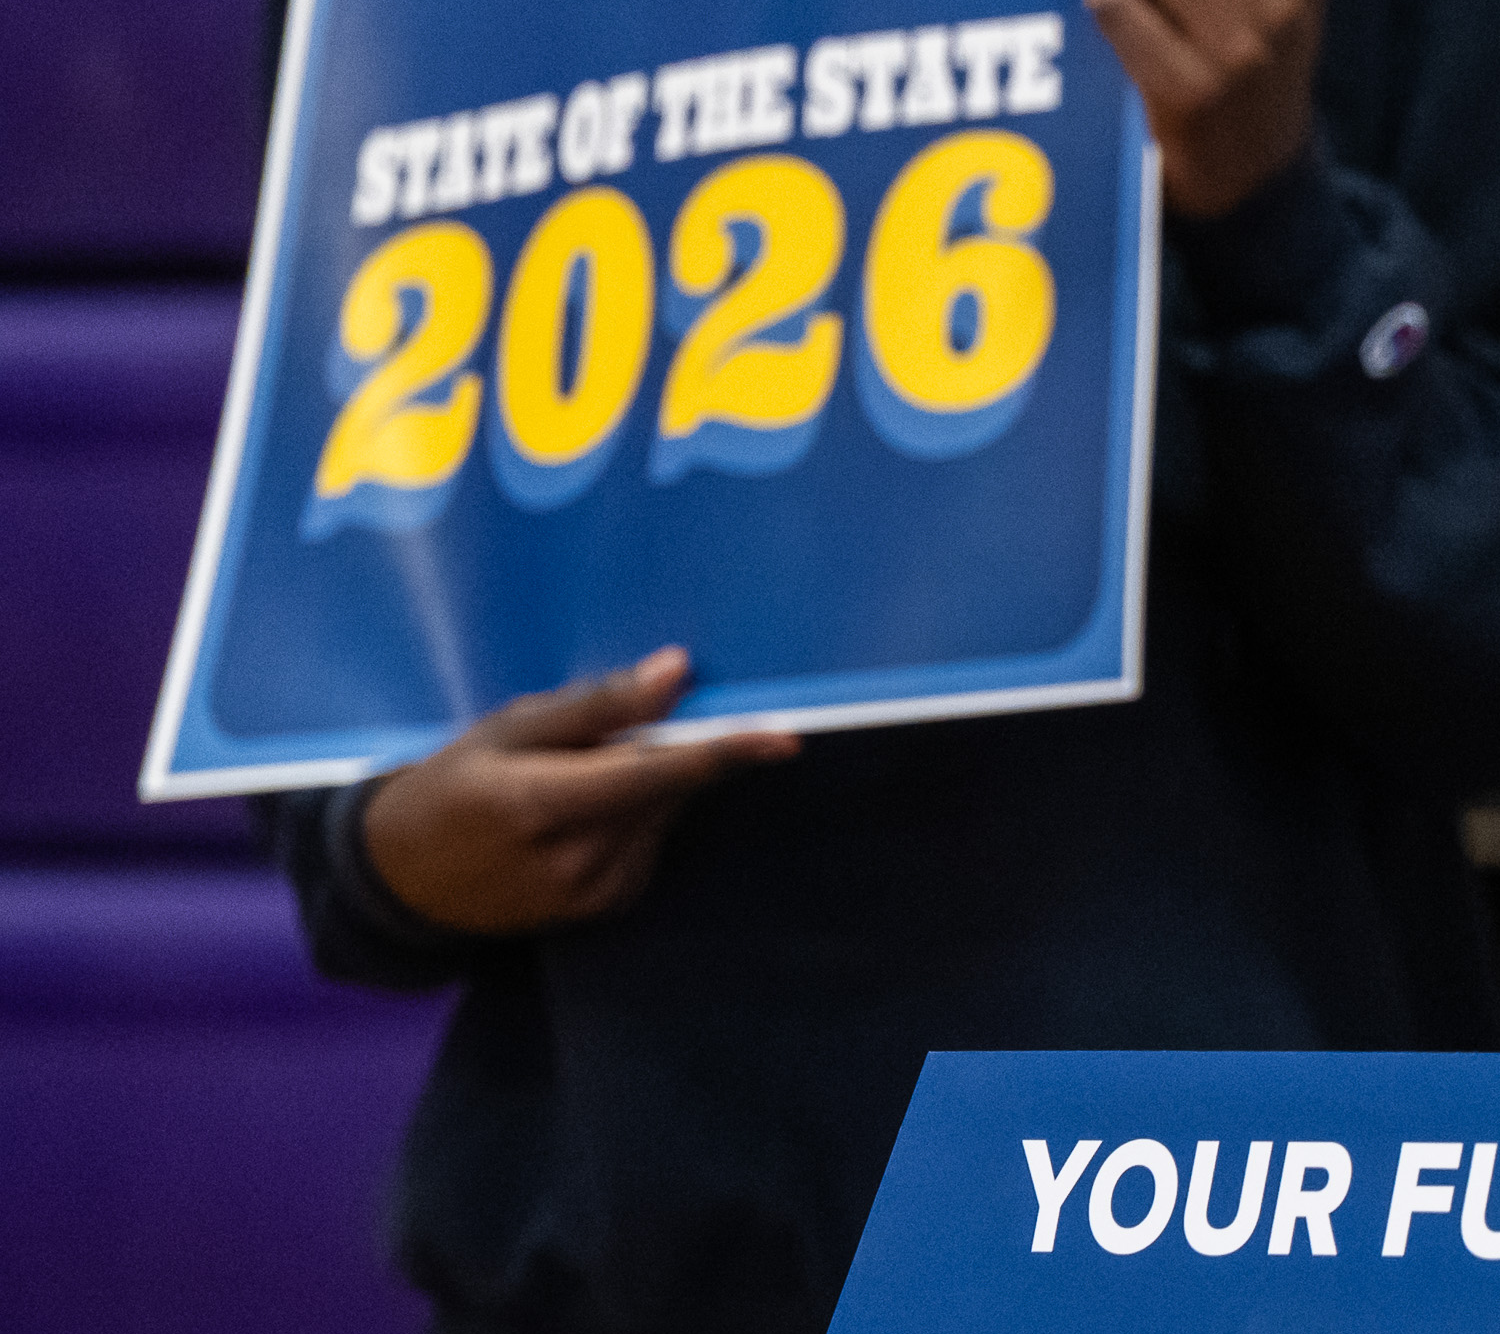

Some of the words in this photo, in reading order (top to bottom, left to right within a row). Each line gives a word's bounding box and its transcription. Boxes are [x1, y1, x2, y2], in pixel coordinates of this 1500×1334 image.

[350, 91, 558, 227] STATE
[557, 71, 648, 182] OF
[653, 43, 797, 162] THE
[803, 12, 1064, 139] STATE
[315, 129, 1056, 498] 2026
[1021, 1138, 1352, 1256] YOUR
